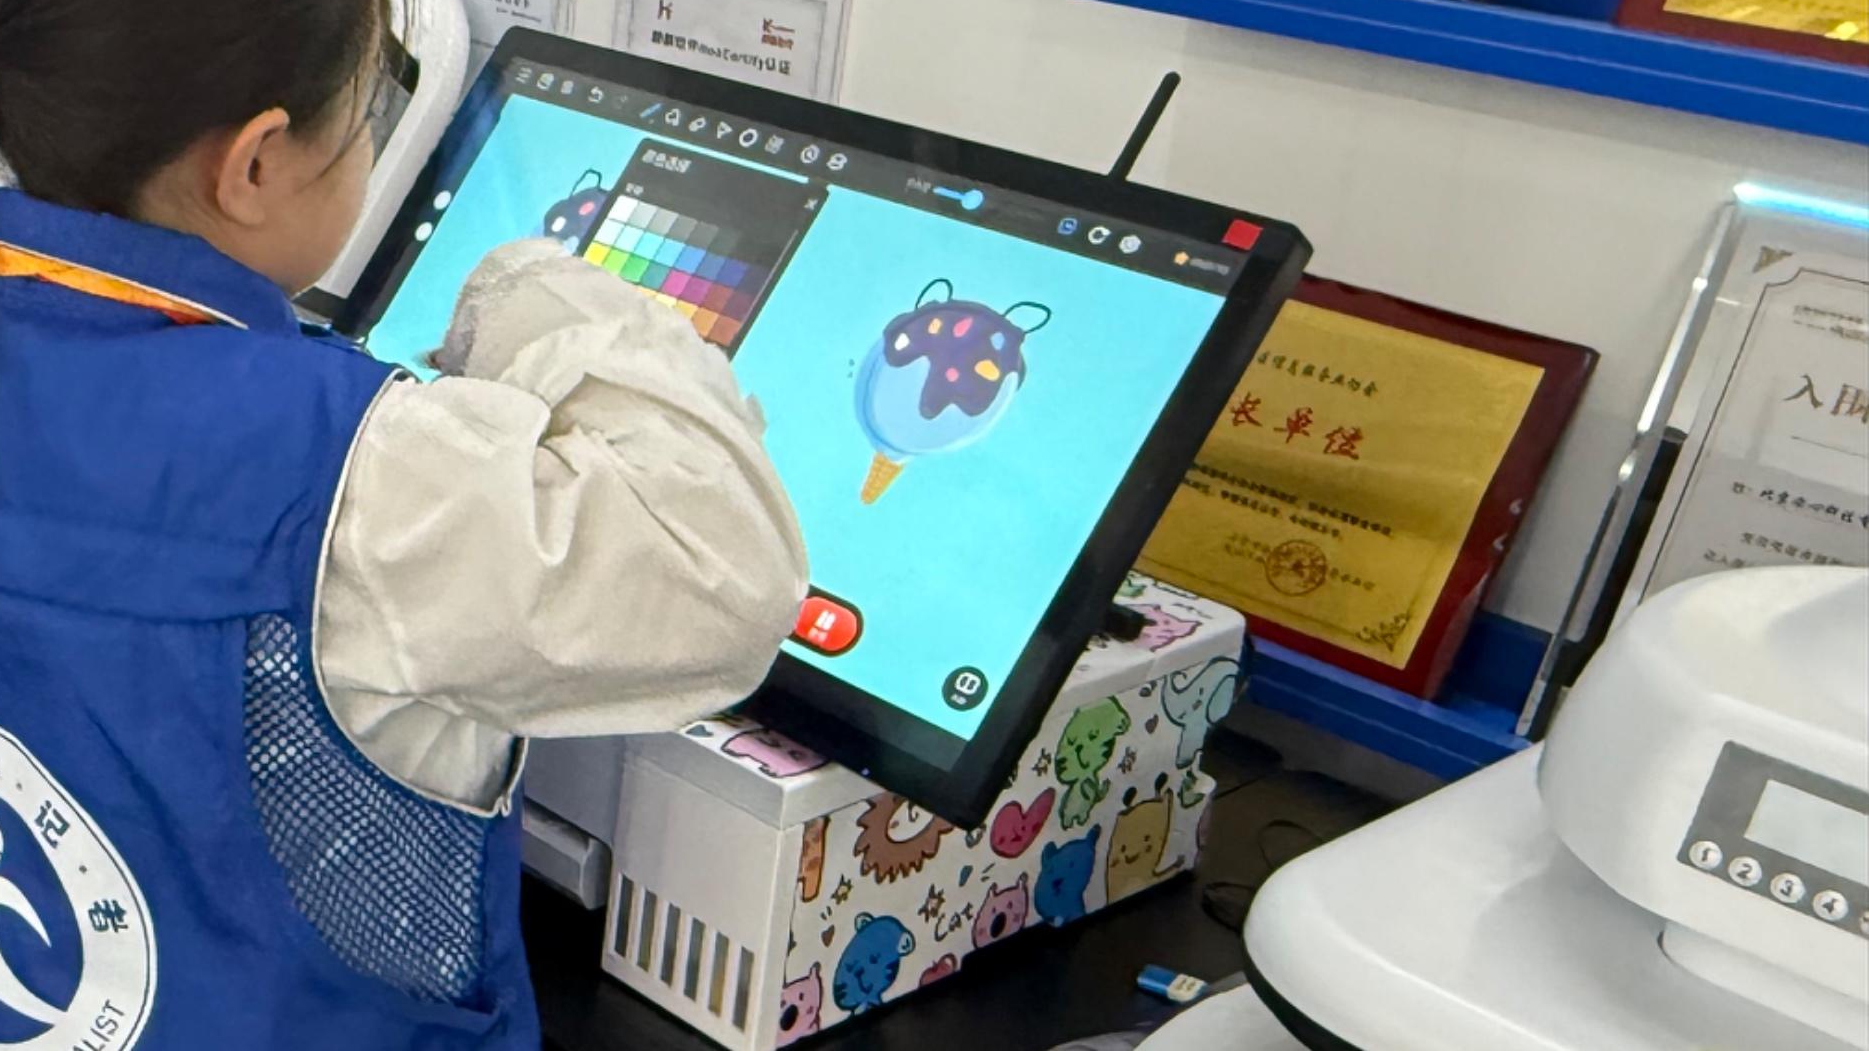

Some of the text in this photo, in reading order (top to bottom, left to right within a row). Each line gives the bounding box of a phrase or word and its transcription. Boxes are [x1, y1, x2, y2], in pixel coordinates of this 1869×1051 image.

[1700, 847, 1711, 862] 1
[1737, 863, 1753, 880] 2
[1780, 880, 1795, 897] 3
[934, 901, 973, 942] Cat
